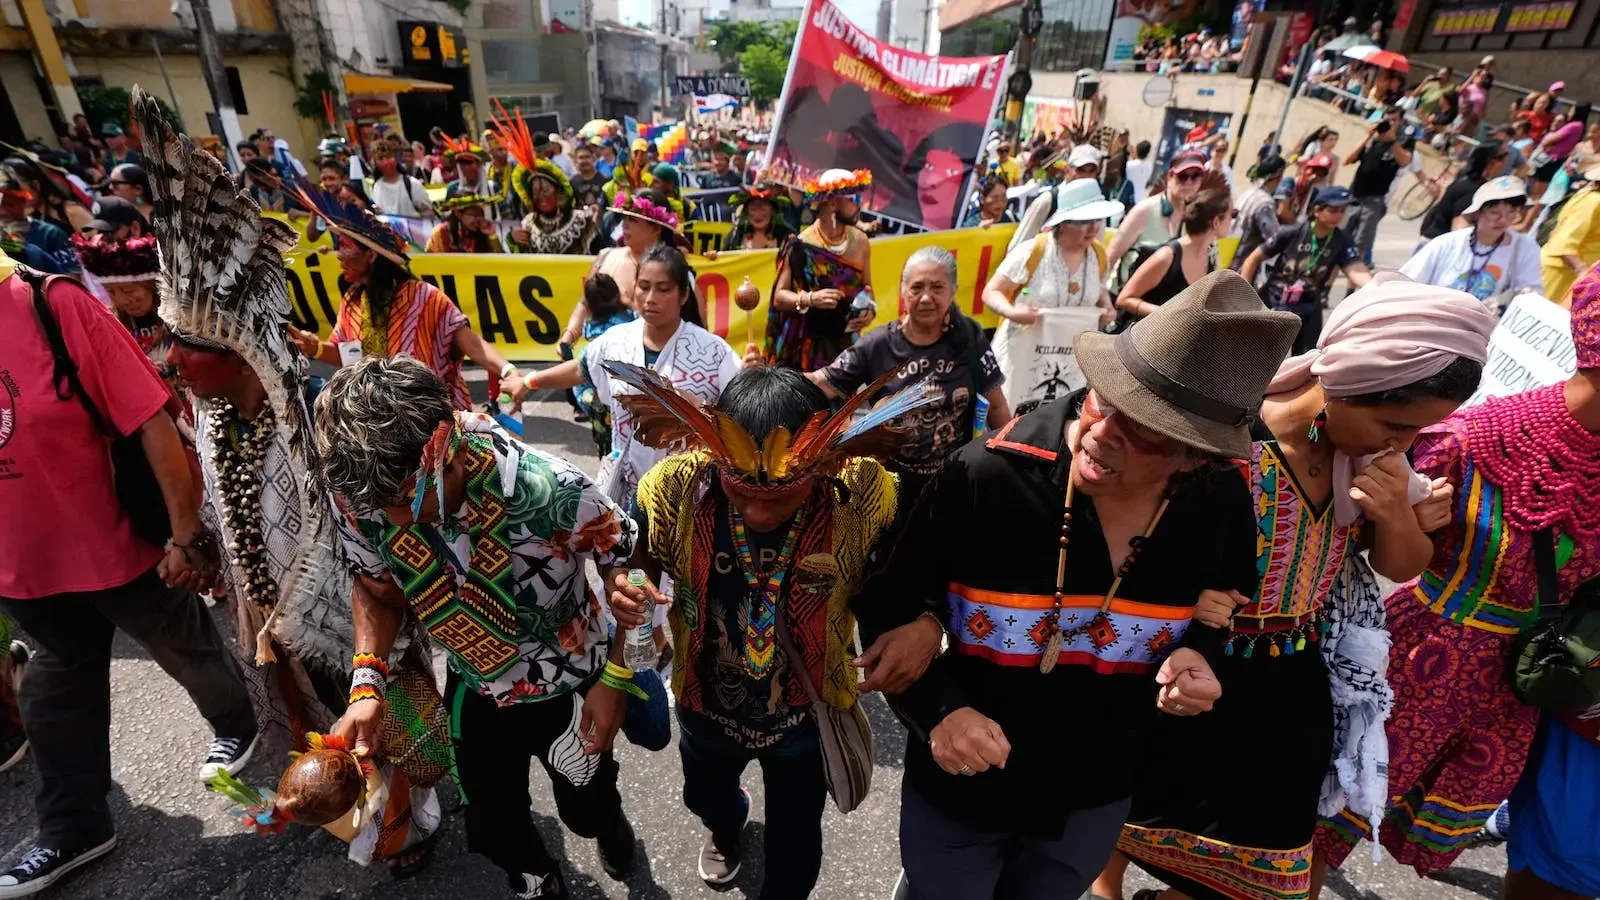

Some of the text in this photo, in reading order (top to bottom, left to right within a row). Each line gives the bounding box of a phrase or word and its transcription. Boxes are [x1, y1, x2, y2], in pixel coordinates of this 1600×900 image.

[812, 2, 880, 62] JUSTIÇA
[881, 50, 980, 87] CLIMÁTICA
[833, 53, 882, 91] JUSTIÇA
[1501, 304, 1577, 374] NDIGENOUS
[897, 359, 955, 379] COP 30
[714, 548, 777, 575] CP
[744, 734, 784, 749] ACRE
